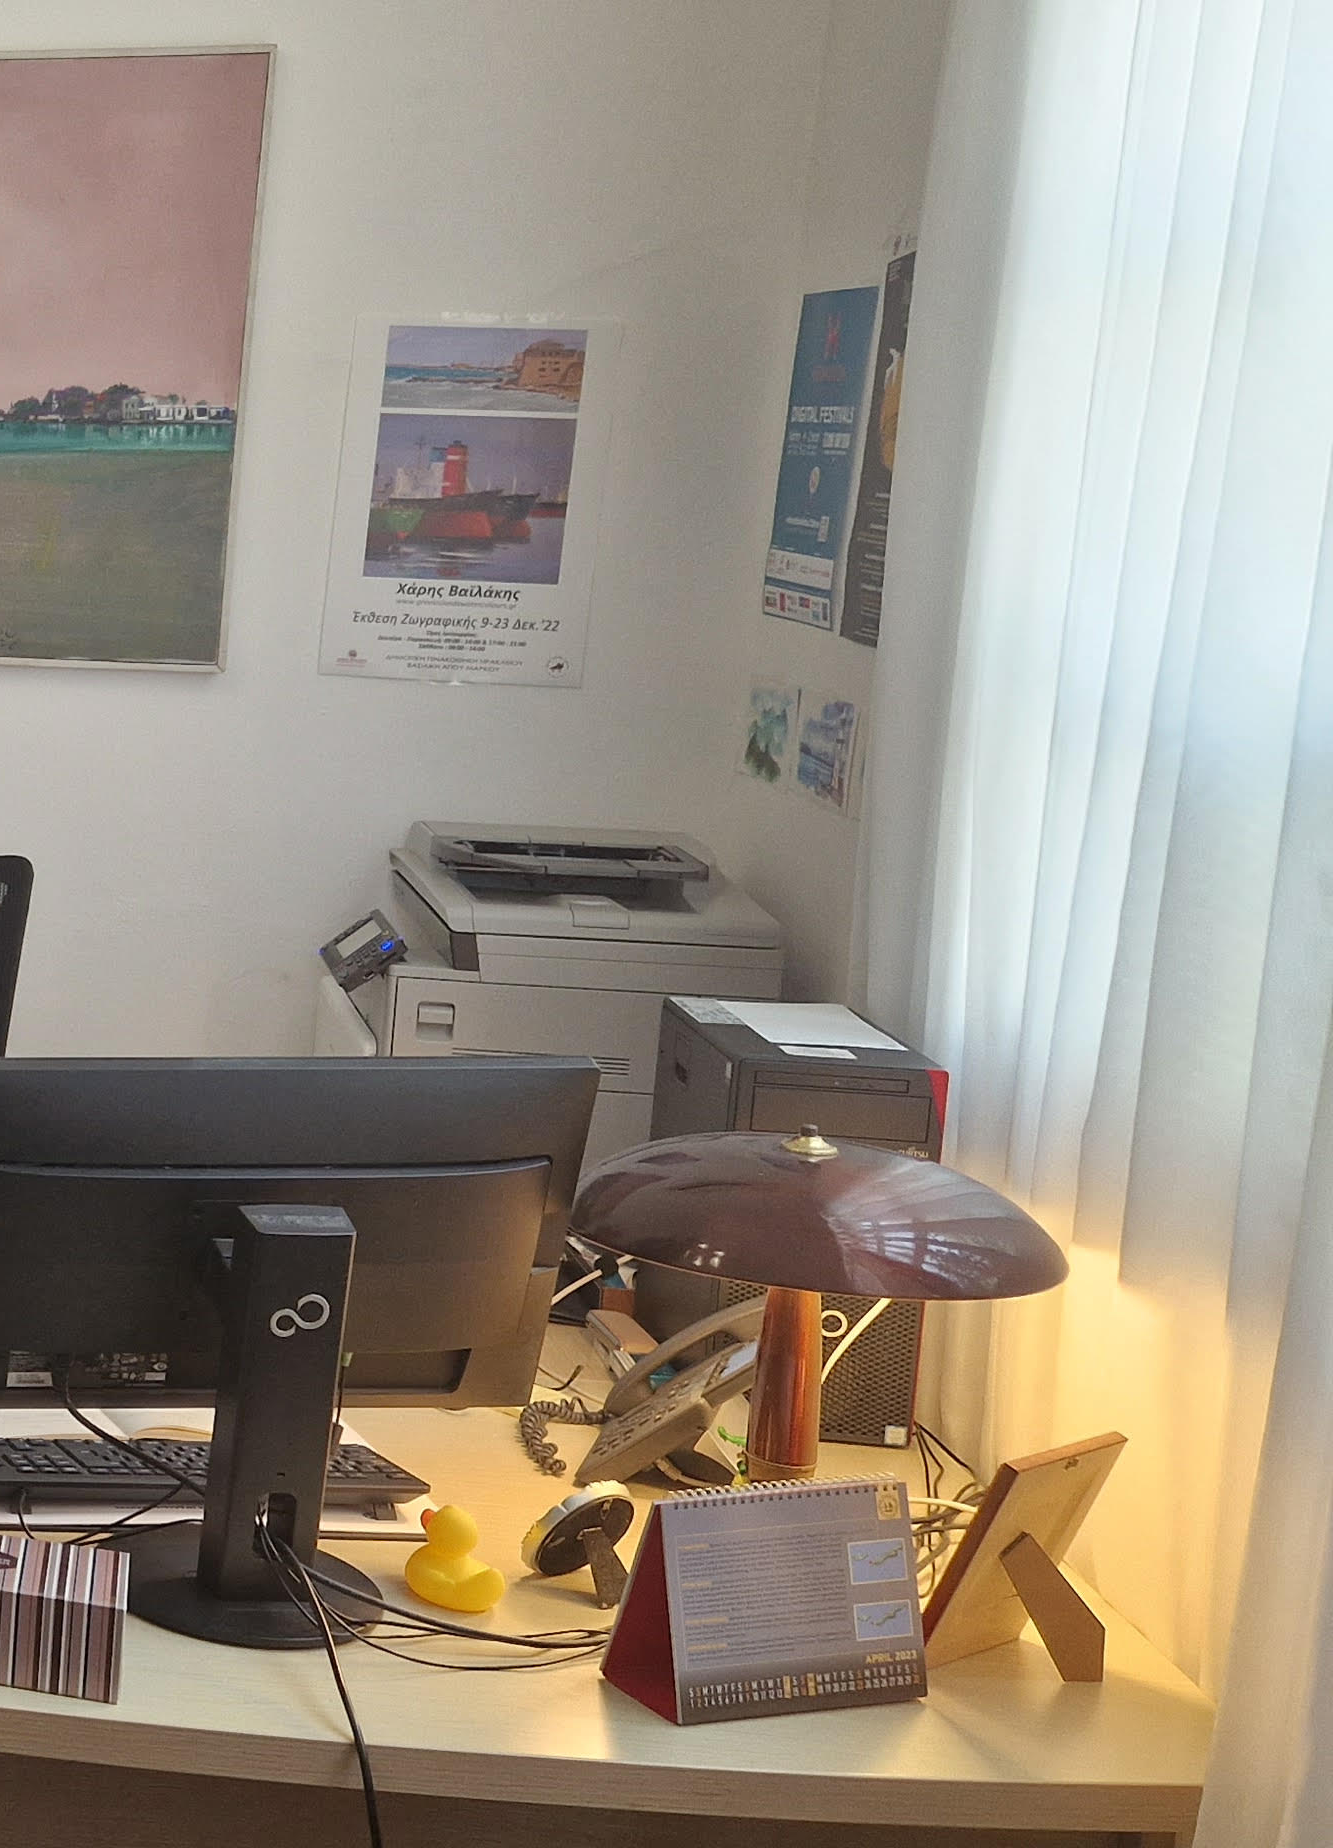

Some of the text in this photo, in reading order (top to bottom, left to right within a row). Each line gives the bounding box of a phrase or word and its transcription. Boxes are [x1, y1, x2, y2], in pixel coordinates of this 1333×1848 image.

[397, 582, 521, 601] Χάρης Βαϊλάκης
[352, 611, 398, 626] Έκθεση
[401, 615, 477, 630] Ζωγραφικής
[480, 617, 509, 629] 9-23
[512, 618, 539, 631] Δεκ.
[865, 1652, 893, 1665] APRIL
